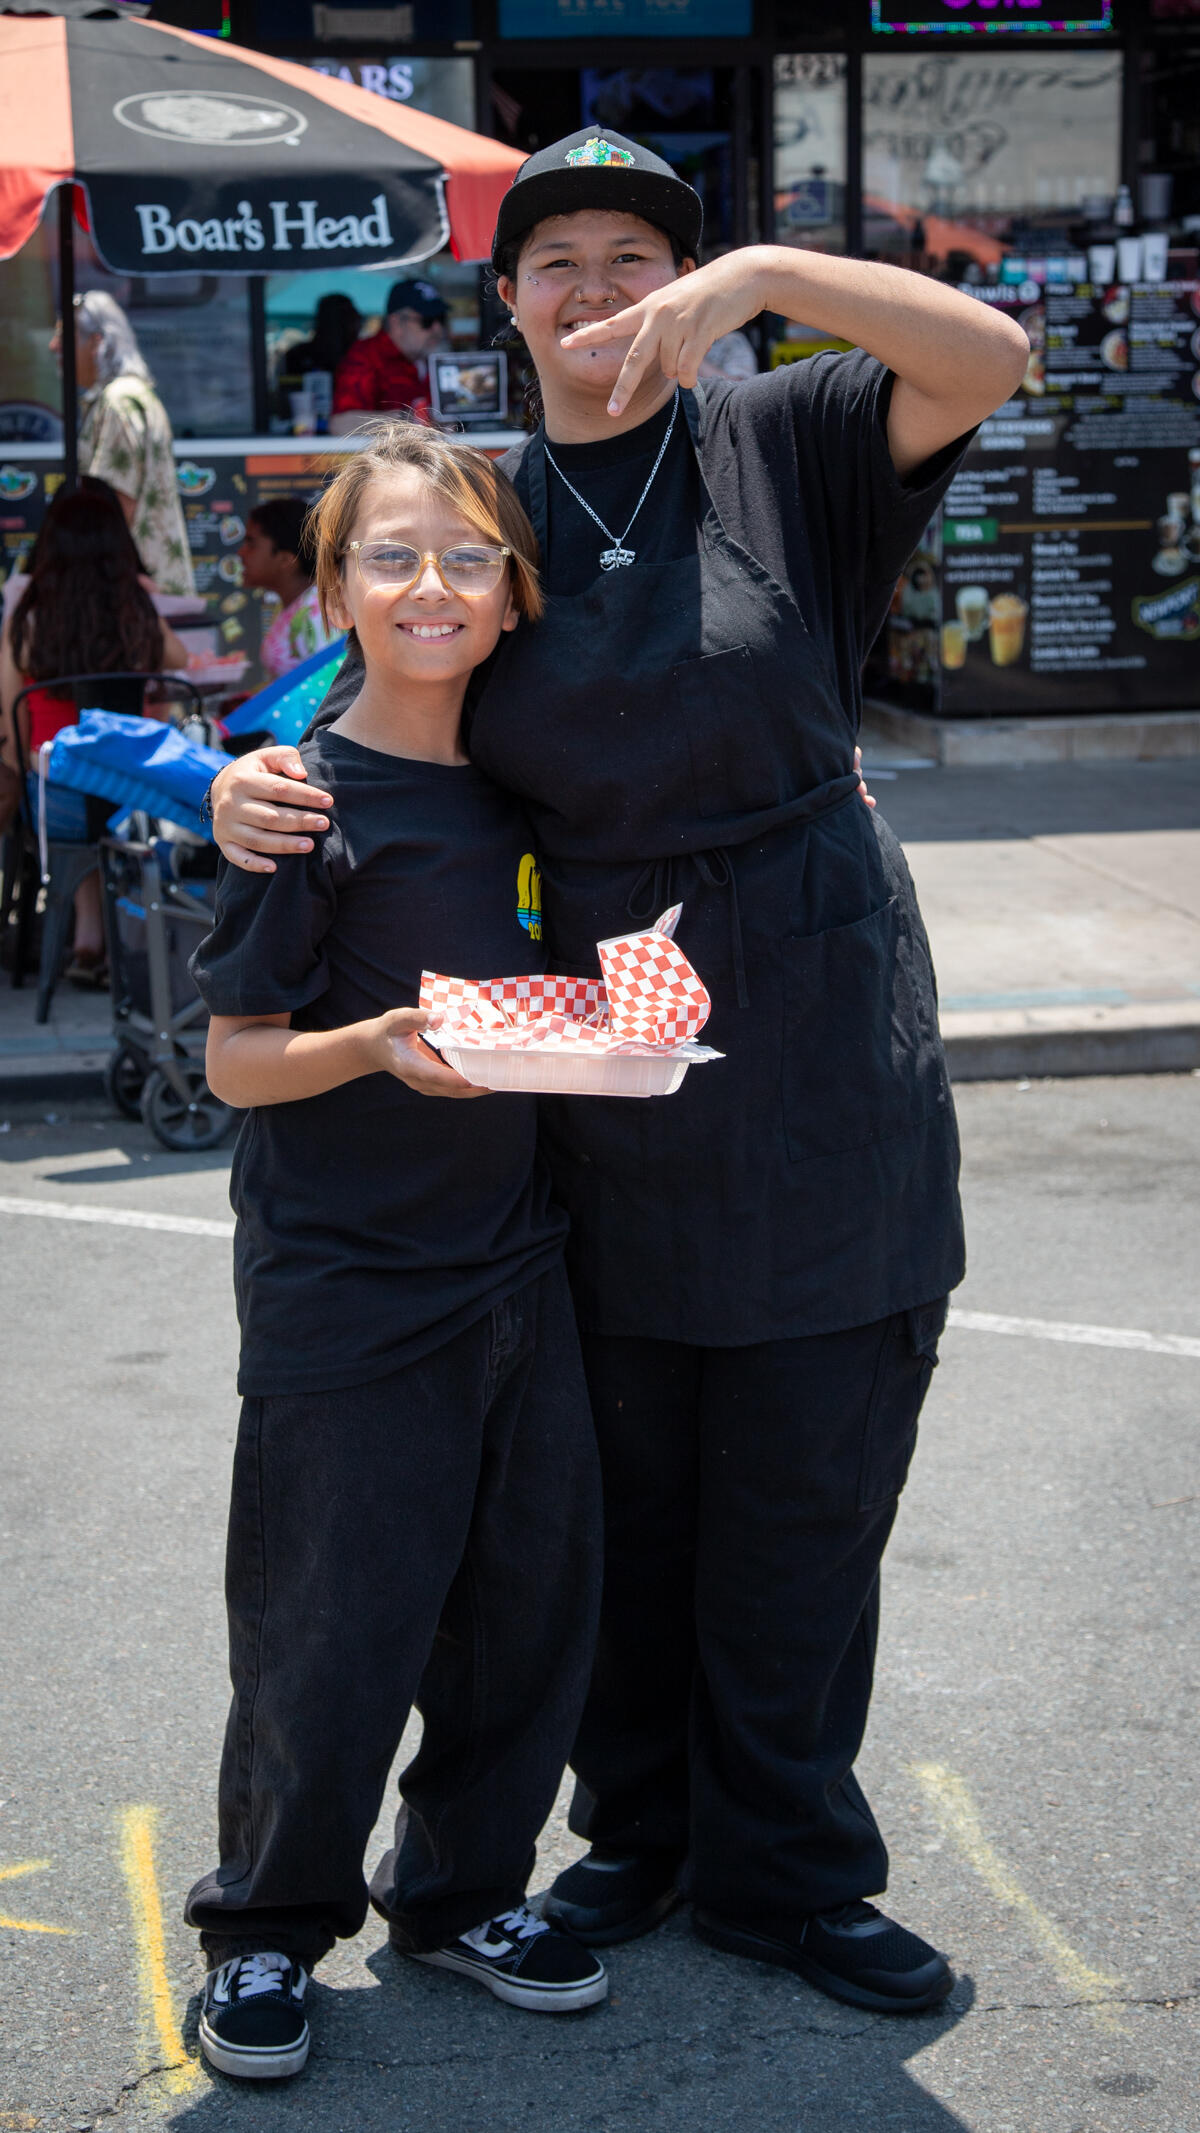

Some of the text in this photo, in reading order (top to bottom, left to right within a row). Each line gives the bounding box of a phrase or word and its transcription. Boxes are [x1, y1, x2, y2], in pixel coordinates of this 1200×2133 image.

[134, 193, 394, 254] Boar's Head
[953, 523, 984, 541] TEA
